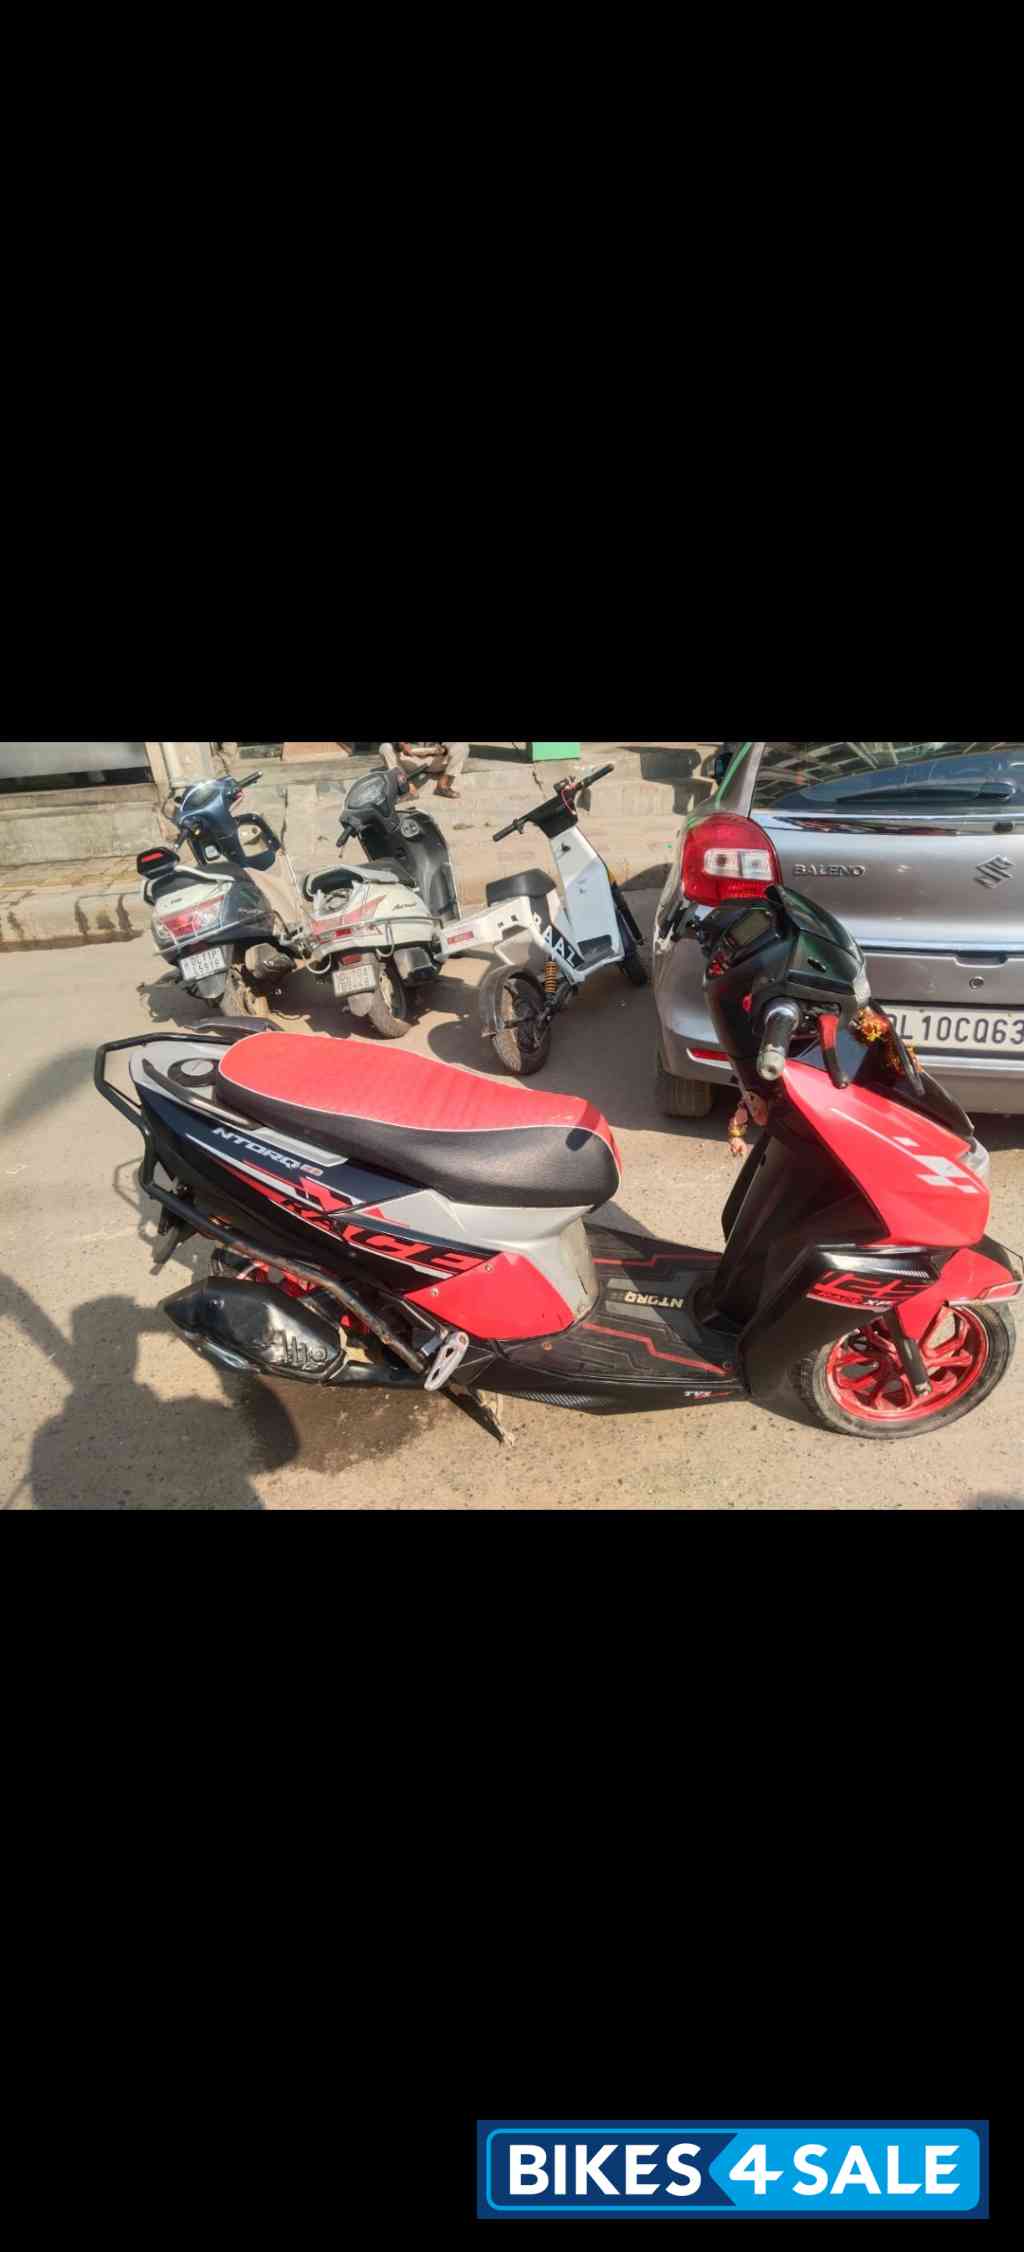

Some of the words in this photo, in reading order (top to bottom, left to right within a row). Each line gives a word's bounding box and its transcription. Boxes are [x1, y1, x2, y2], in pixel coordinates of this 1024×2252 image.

[793, 863, 866, 876] BALENO
[212, 1127, 301, 1169] NTORQ
[284, 1199, 491, 1276] RACE
[624, 1291, 684, 1308] NTORQ
